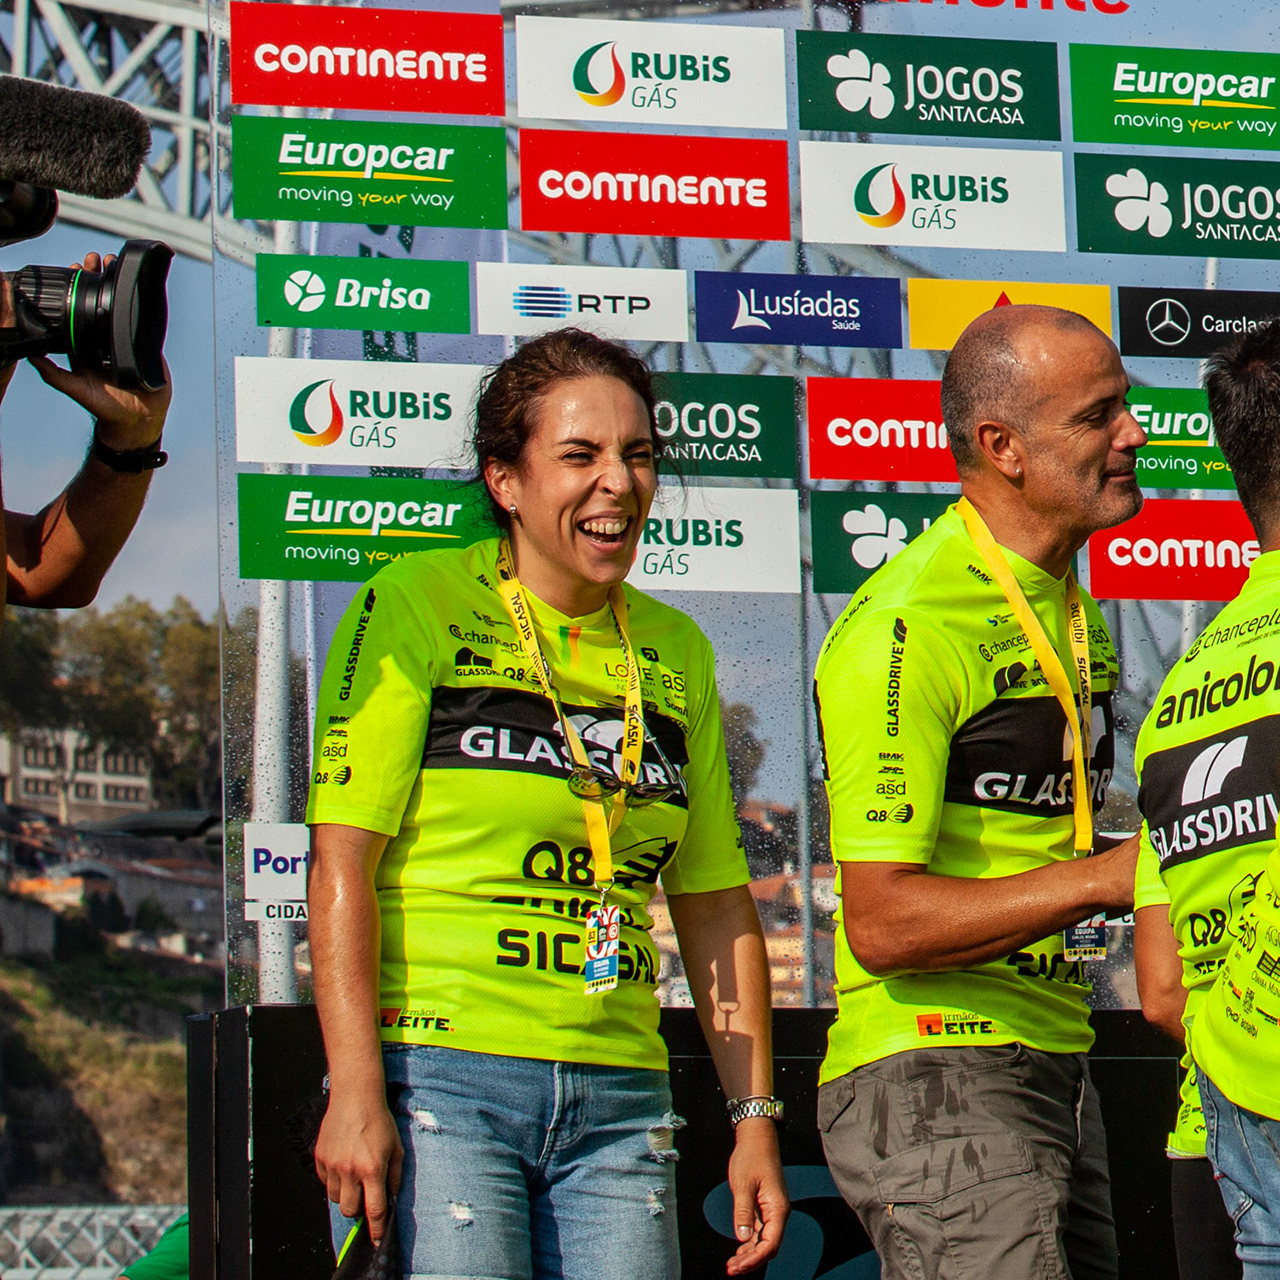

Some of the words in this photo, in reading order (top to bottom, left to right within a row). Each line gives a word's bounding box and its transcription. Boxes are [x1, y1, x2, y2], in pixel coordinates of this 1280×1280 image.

[254, 42, 487, 83] CONTINENTE
[631, 84, 678, 110] GÁS
[904, 62, 1024, 111] JOGOS
[1113, 62, 1276, 106] Europcar
[918, 103, 1025, 126] SANTACASA
[1114, 112, 1183, 135] moving
[1188, 117, 1234, 134] your
[1236, 119, 1278, 137] way
[278, 132, 455, 179] Europcar
[278, 186, 353, 207] moving
[357, 190, 408, 207] your
[410, 192, 455, 211] way
[537, 170, 768, 208] CONTINENTE
[911, 206, 957, 230] GÁS
[334, 278, 432, 311] Brisa
[577, 293, 652, 315] RTP
[749, 288, 861, 320] Lusíadas
[831, 319, 862, 332] Saúde
[653, 400, 762, 440] OGOS
[349, 422, 397, 449] GÁS
[656, 441, 762, 462] ANTACASA
[285, 490, 462, 537] Europcar
[285, 545, 361, 566] moving
[643, 550, 691, 577] GÁS
[1107, 537, 1261, 568] CONTINE
[510, 591, 533, 642] SICASAL
[339, 613, 371, 701] GLASSDRIVE
[990, 633, 1030, 657] chancep
[503, 666, 526, 682] Q8
[605, 662, 655, 682] LOE
[1077, 656, 1089, 707] SICASAL
[888, 641, 906, 737] GLASSDRIVE
[626, 704, 638, 749] SICASAL
[315, 771, 329, 785] Q8
[866, 809, 887, 822] Q8
[522, 839, 596, 887] Q8
[265, 904, 308, 919] CIDA
[1188, 908, 1228, 948] Q8
